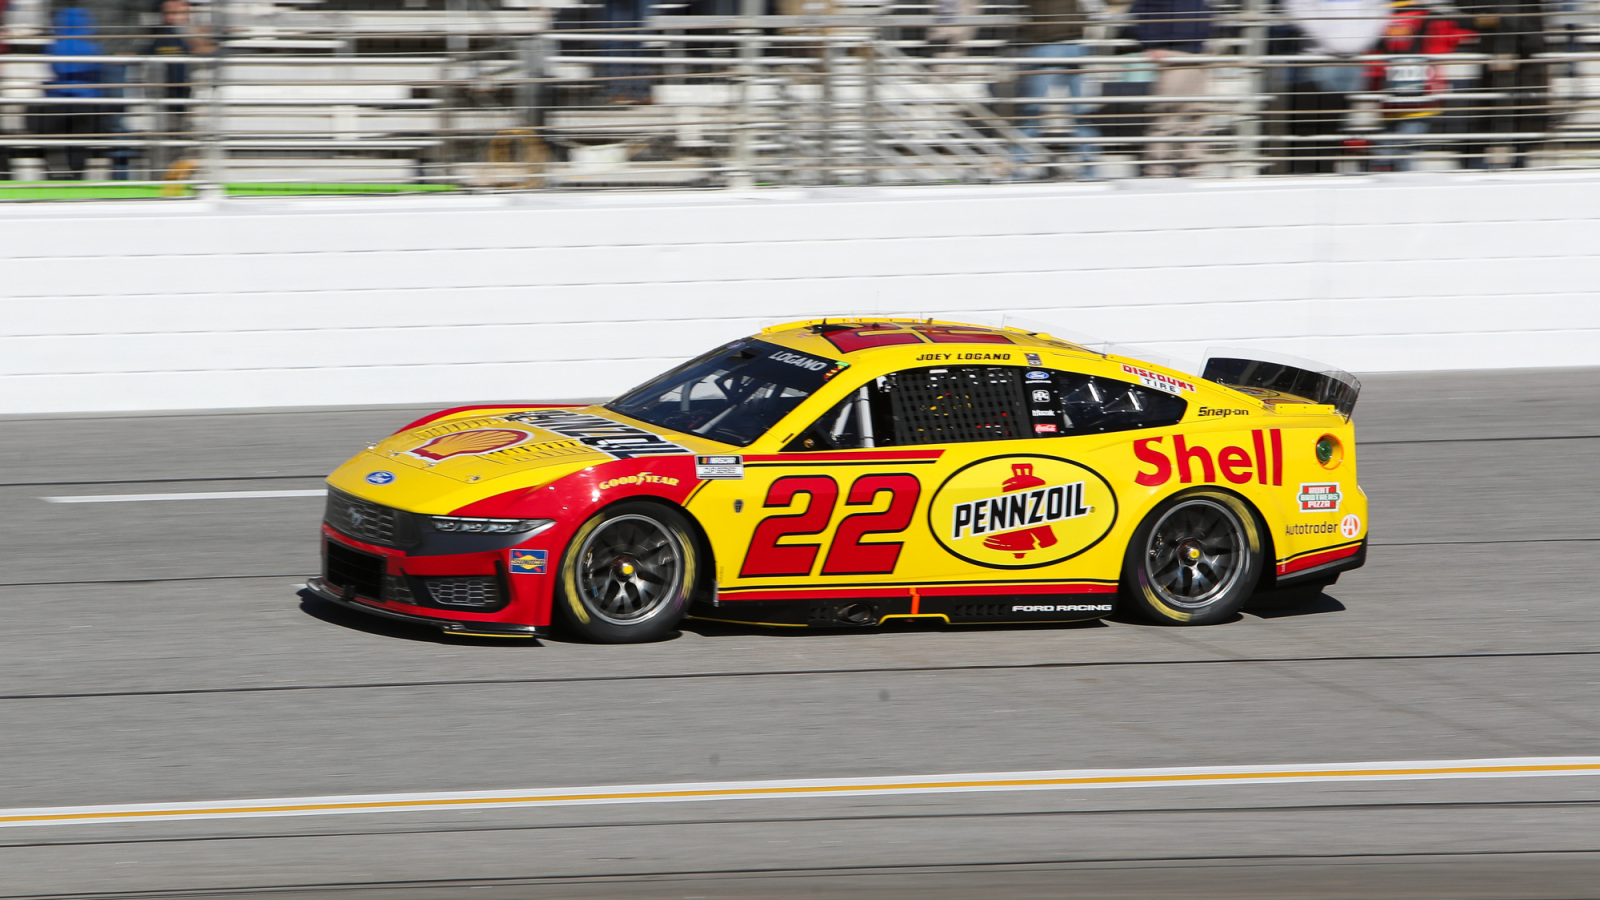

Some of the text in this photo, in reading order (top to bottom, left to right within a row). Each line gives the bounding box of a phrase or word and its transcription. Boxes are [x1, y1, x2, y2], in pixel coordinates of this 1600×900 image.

[768, 351, 828, 371] LOGANO
[916, 352, 1011, 361] JOEY LOGANO
[1122, 364, 1197, 392] DISCOUNT
[1144, 378, 1177, 392] TIRE
[1198, 406, 1250, 418] Snap-on
[1133, 428, 1283, 487] Shell
[599, 472, 680, 489] GOODYEAR
[1300, 493, 1339, 501] BROTHERS
[952, 482, 1090, 540] PENNZOIL
[737, 472, 921, 578] 22
[1285, 521, 1338, 535] Autotrader
[1056, 604, 1113, 612] RACING
